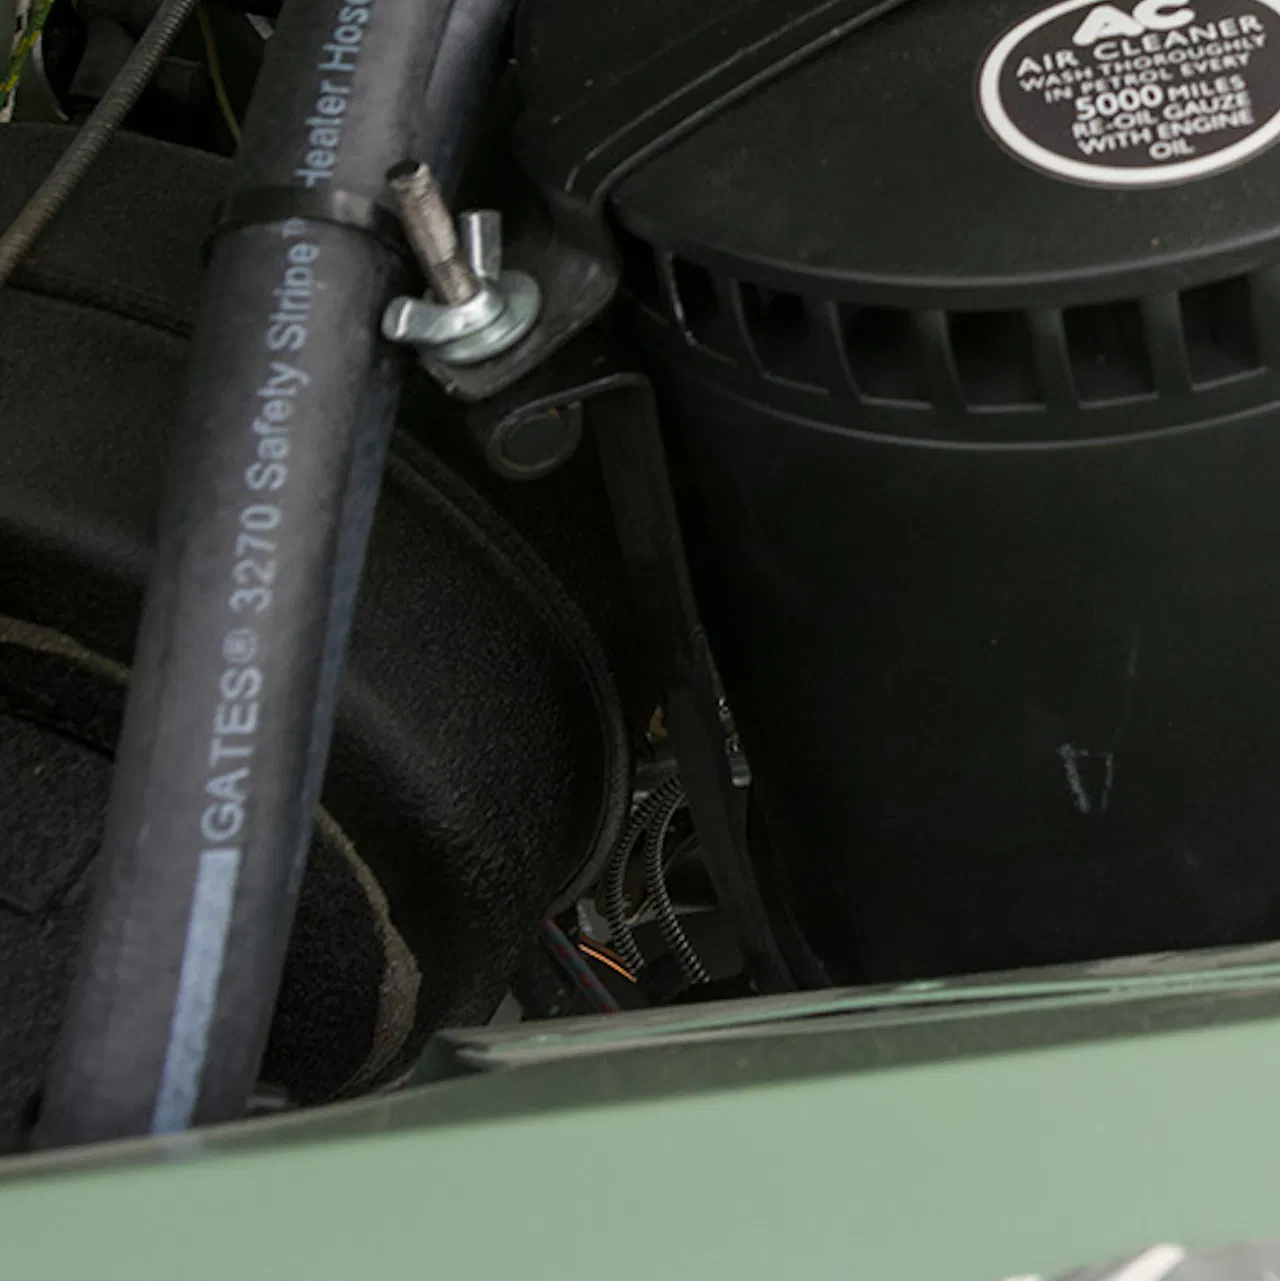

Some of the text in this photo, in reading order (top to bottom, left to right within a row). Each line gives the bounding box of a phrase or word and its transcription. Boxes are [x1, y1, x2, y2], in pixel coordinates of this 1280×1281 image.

[1016, 14, 1265, 78] AIR CLEANER
[1019, 33, 1267, 92] WASH THOROUGHLY
[1044, 52, 1251, 104] IN PETROL EVERY
[1074, 73, 1247, 122] 5000 MILES
[1162, 91, 1250, 119] GAUZE
[1077, 108, 1255, 156] WITH ENGINE
[1149, 138, 1195, 160] OIL
[229, 504, 283, 614] 3270
